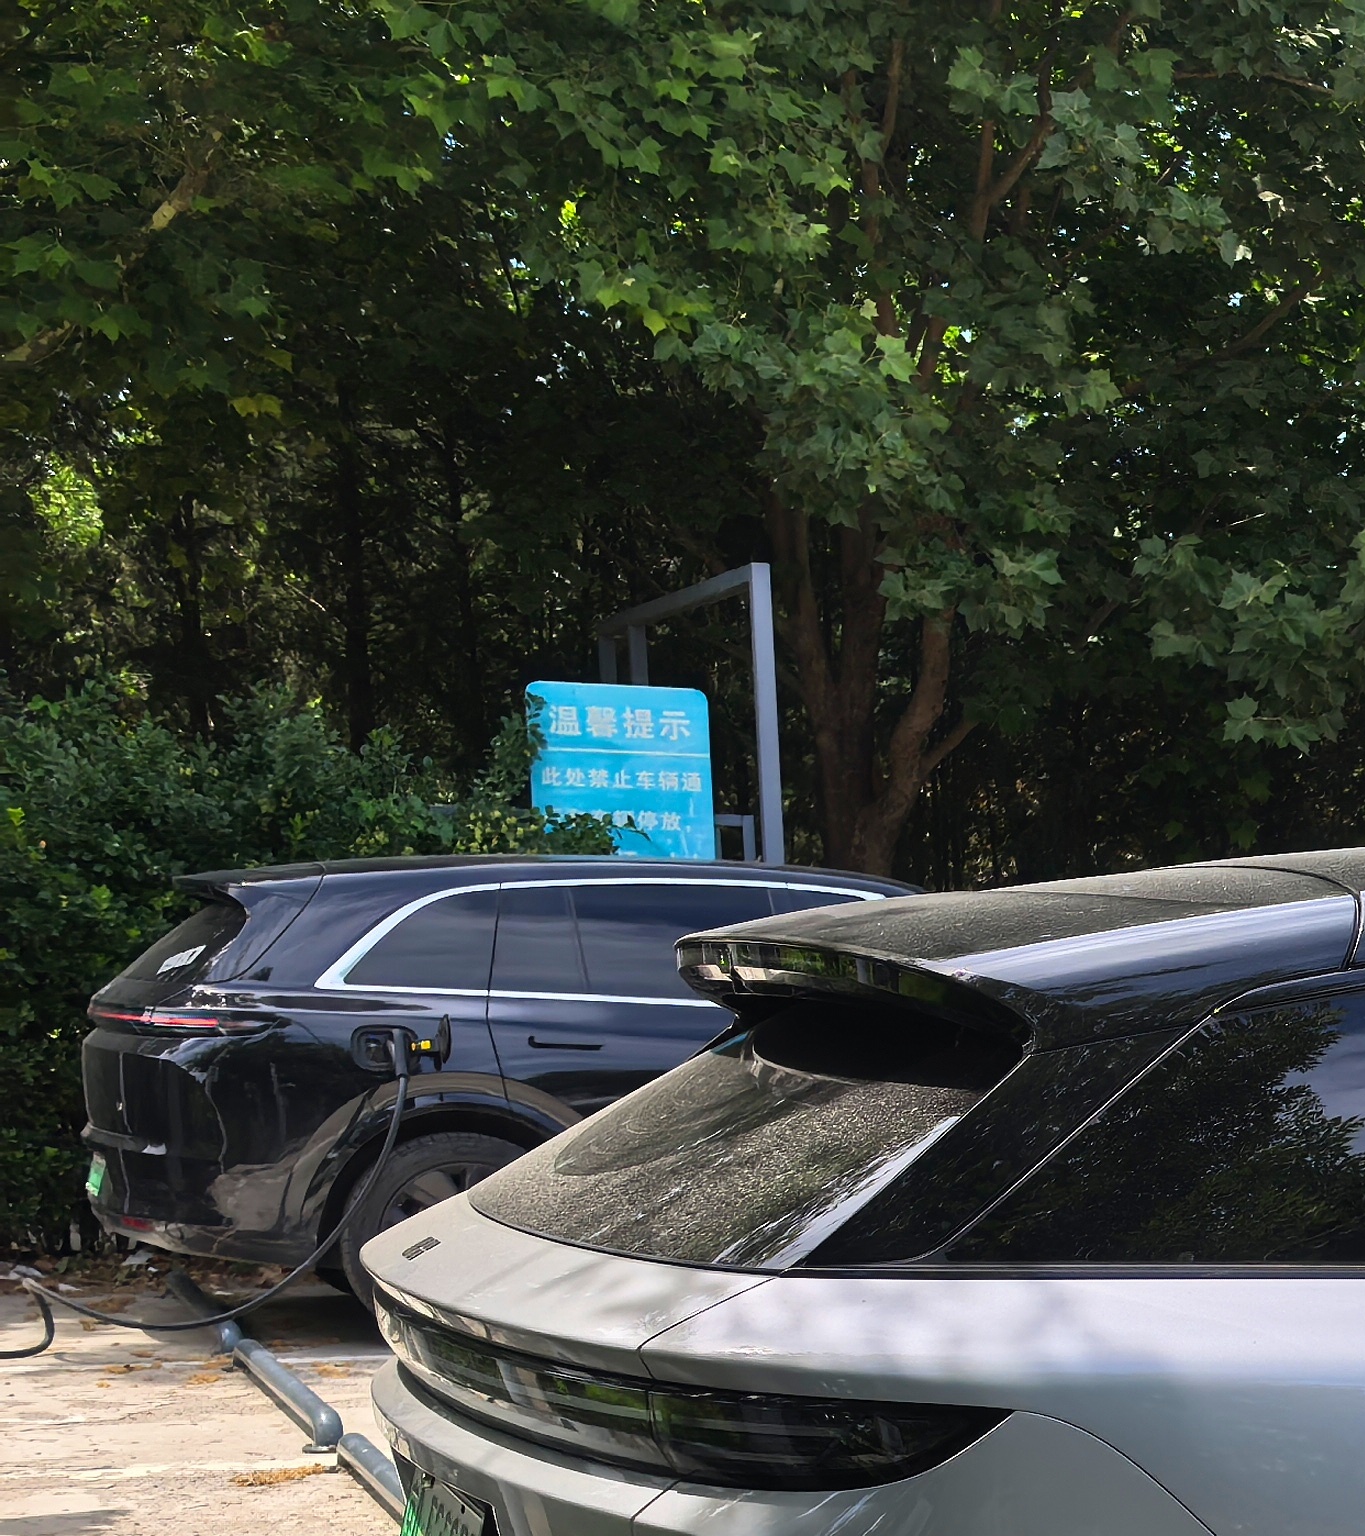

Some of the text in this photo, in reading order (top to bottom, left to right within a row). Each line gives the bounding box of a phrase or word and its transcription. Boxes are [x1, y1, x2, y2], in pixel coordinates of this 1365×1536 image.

[549, 705, 691, 741] 温馨提示
[541, 766, 702, 792] 此处禁止车辆通
